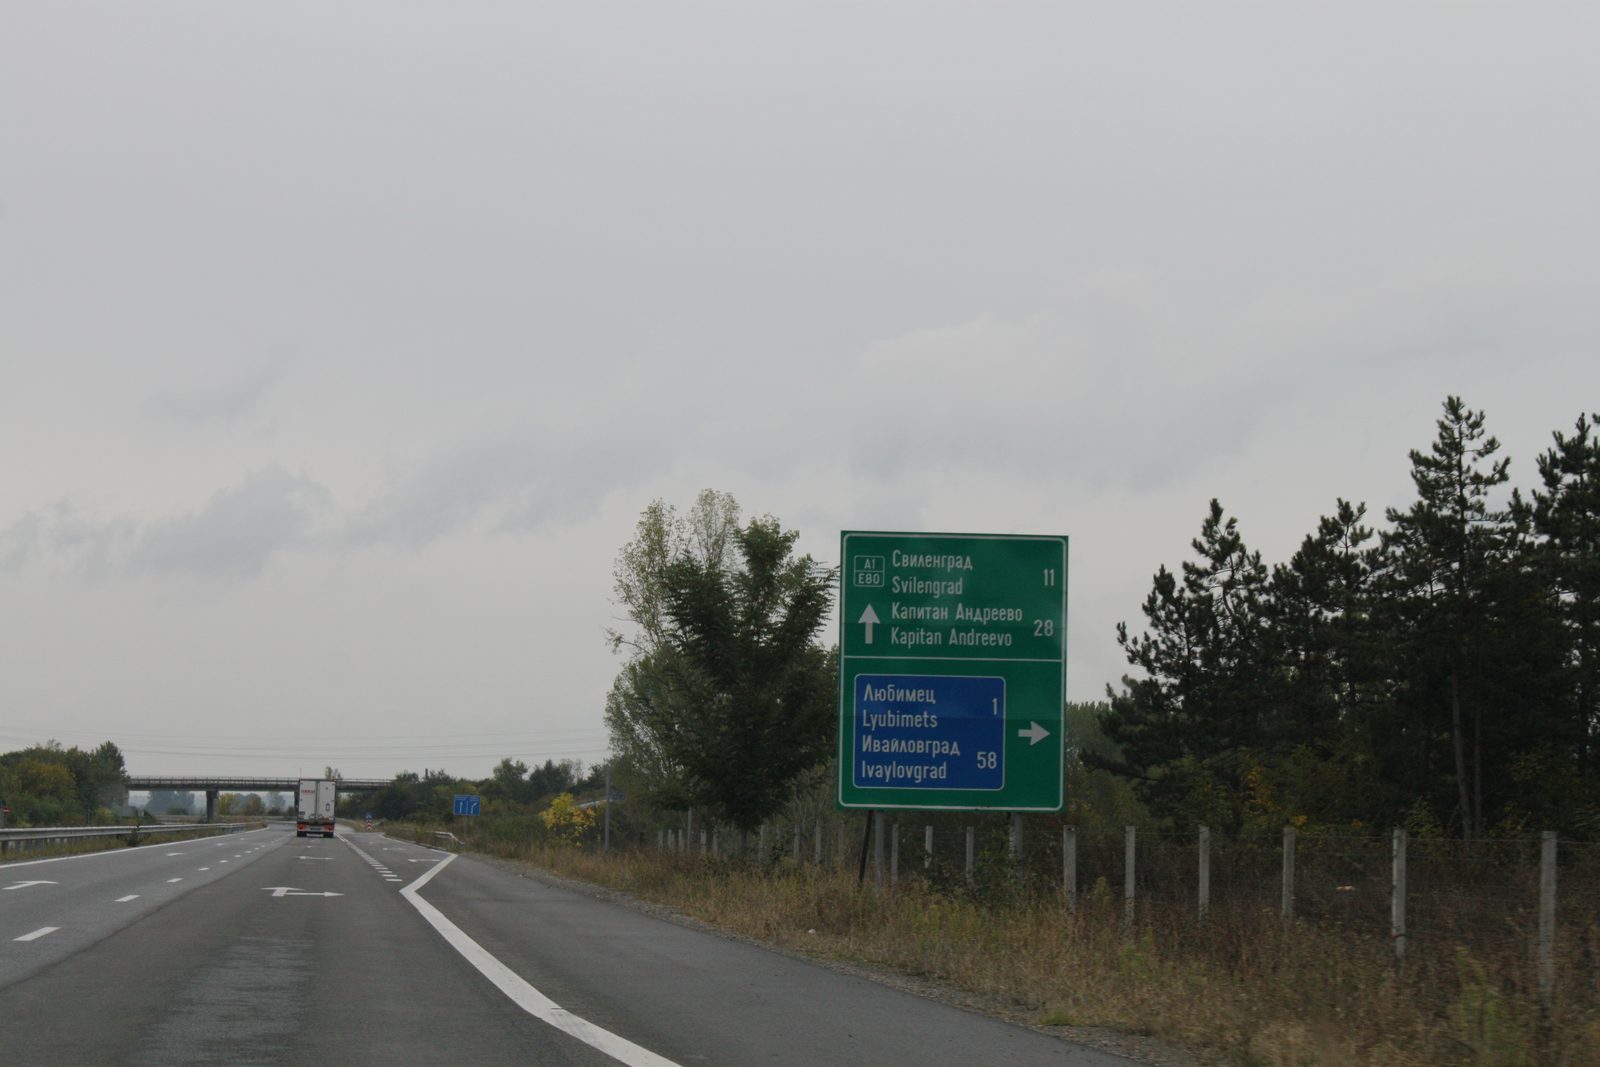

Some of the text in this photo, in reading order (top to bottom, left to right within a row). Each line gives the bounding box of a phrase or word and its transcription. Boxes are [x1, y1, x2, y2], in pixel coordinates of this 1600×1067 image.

[864, 558, 876, 570] A1
[892, 550, 973, 571] Свиленград
[858, 573, 880, 585] E80
[892, 576, 963, 598] Svilengrad
[1043, 568, 1055, 586] 11
[891, 602, 1023, 625] Капитан Андреево
[891, 627, 1013, 648] Kapitan Andreevo
[1033, 619, 1054, 637] 28
[863, 684, 936, 704] Любимец
[992, 698, 998, 716] 1
[862, 710, 938, 731] Lyubimets
[862, 735, 960, 758] Ивайловград
[976, 752, 998, 769] 58
[861, 760, 947, 784] Ivaylovgrad
